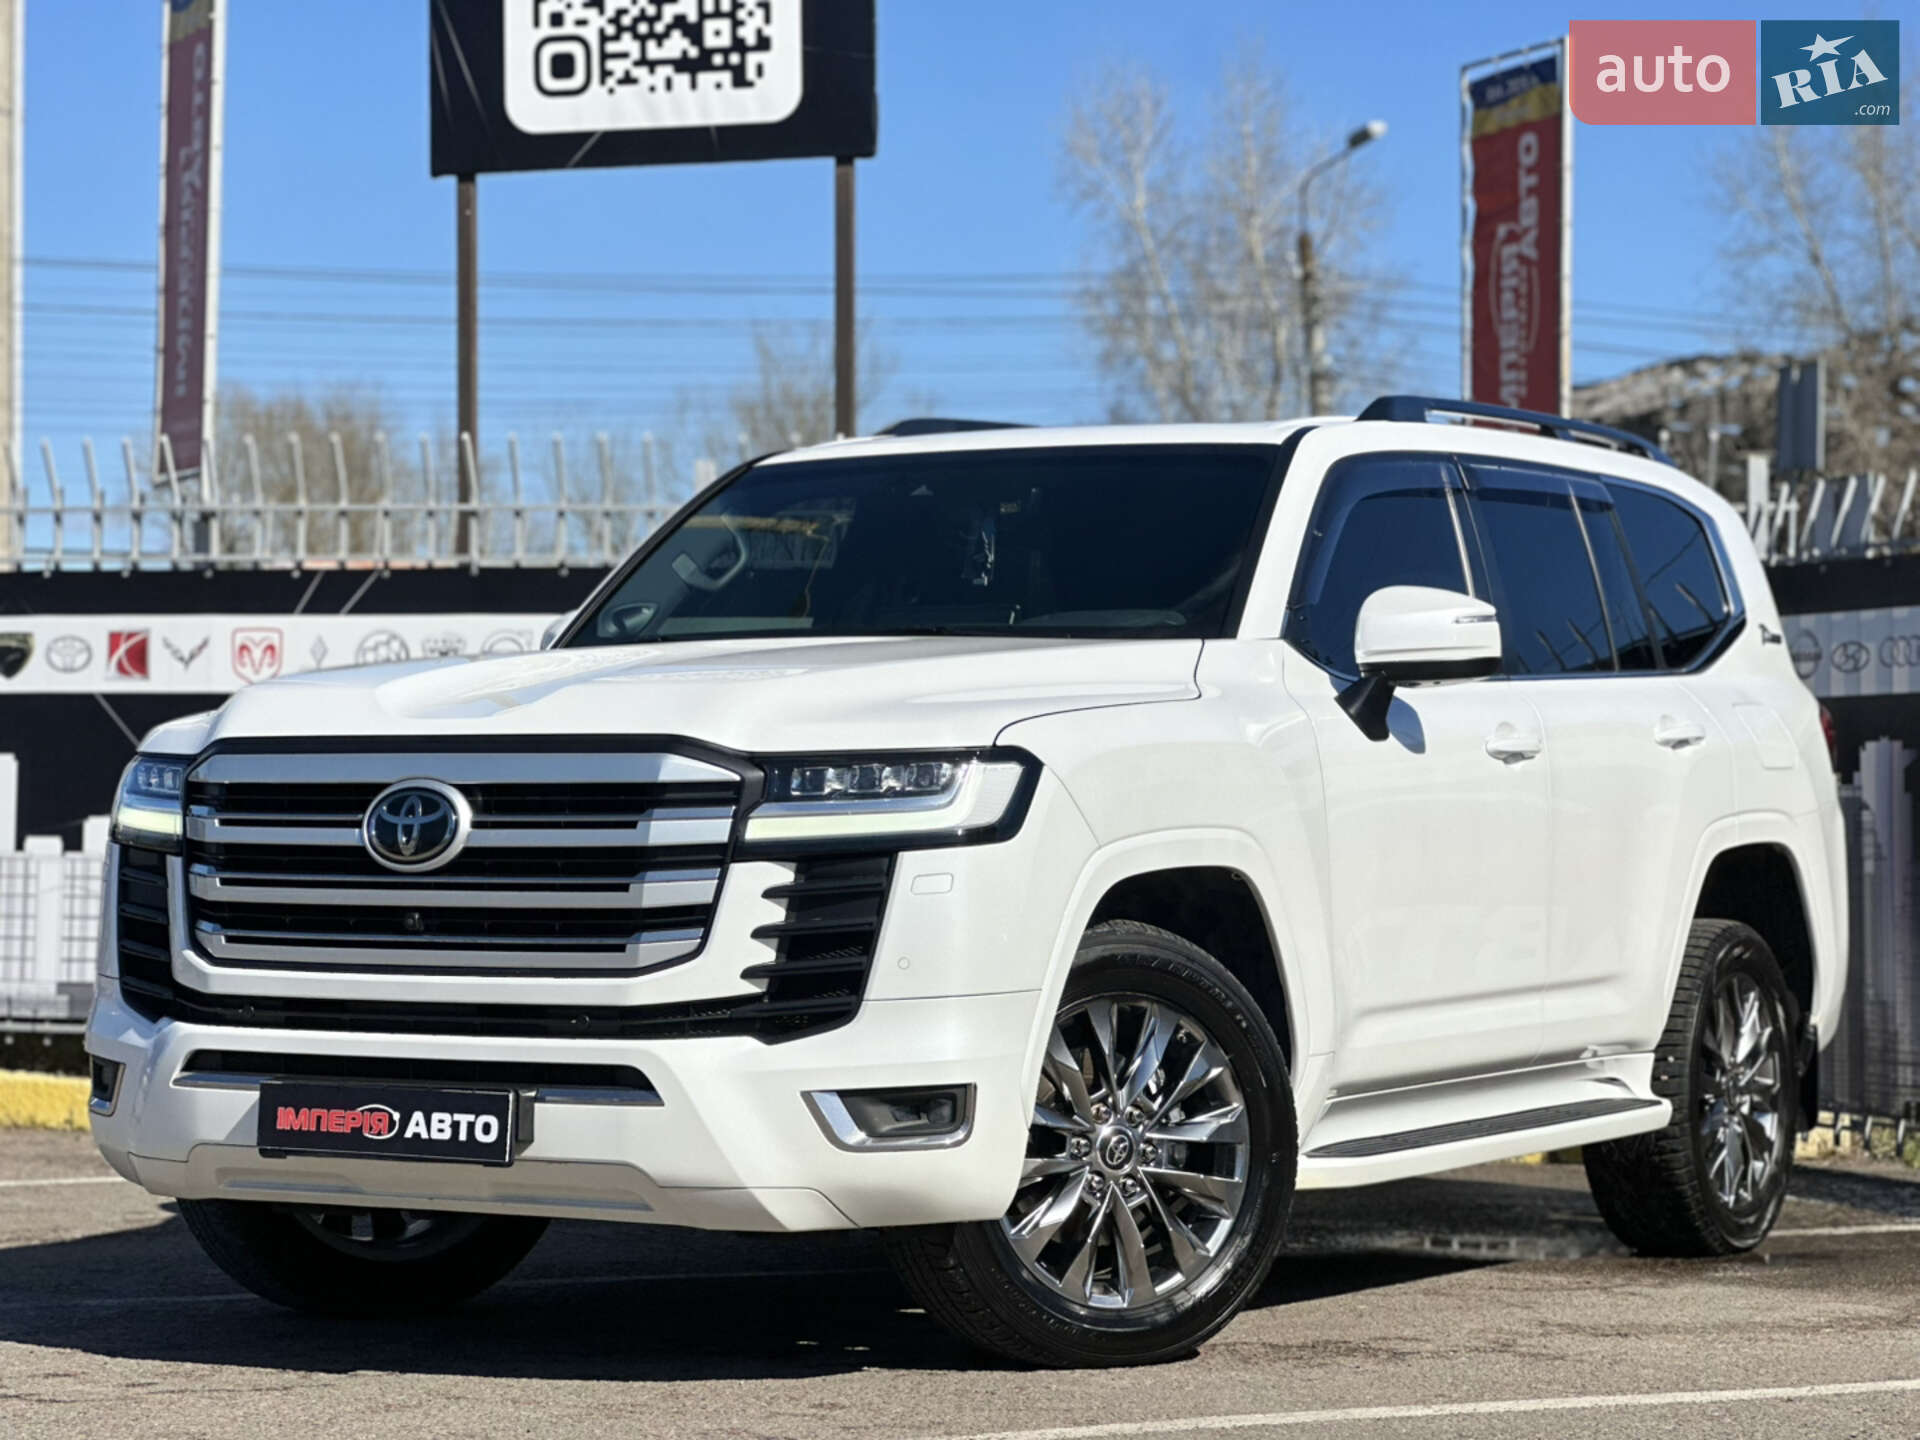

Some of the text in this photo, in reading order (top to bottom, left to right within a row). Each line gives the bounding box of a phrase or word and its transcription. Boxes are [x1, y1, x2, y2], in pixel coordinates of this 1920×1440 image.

[1518, 133, 1540, 262] АВТО
[276, 1107, 499, 1144] ІМПЕРІЯ АВТО
